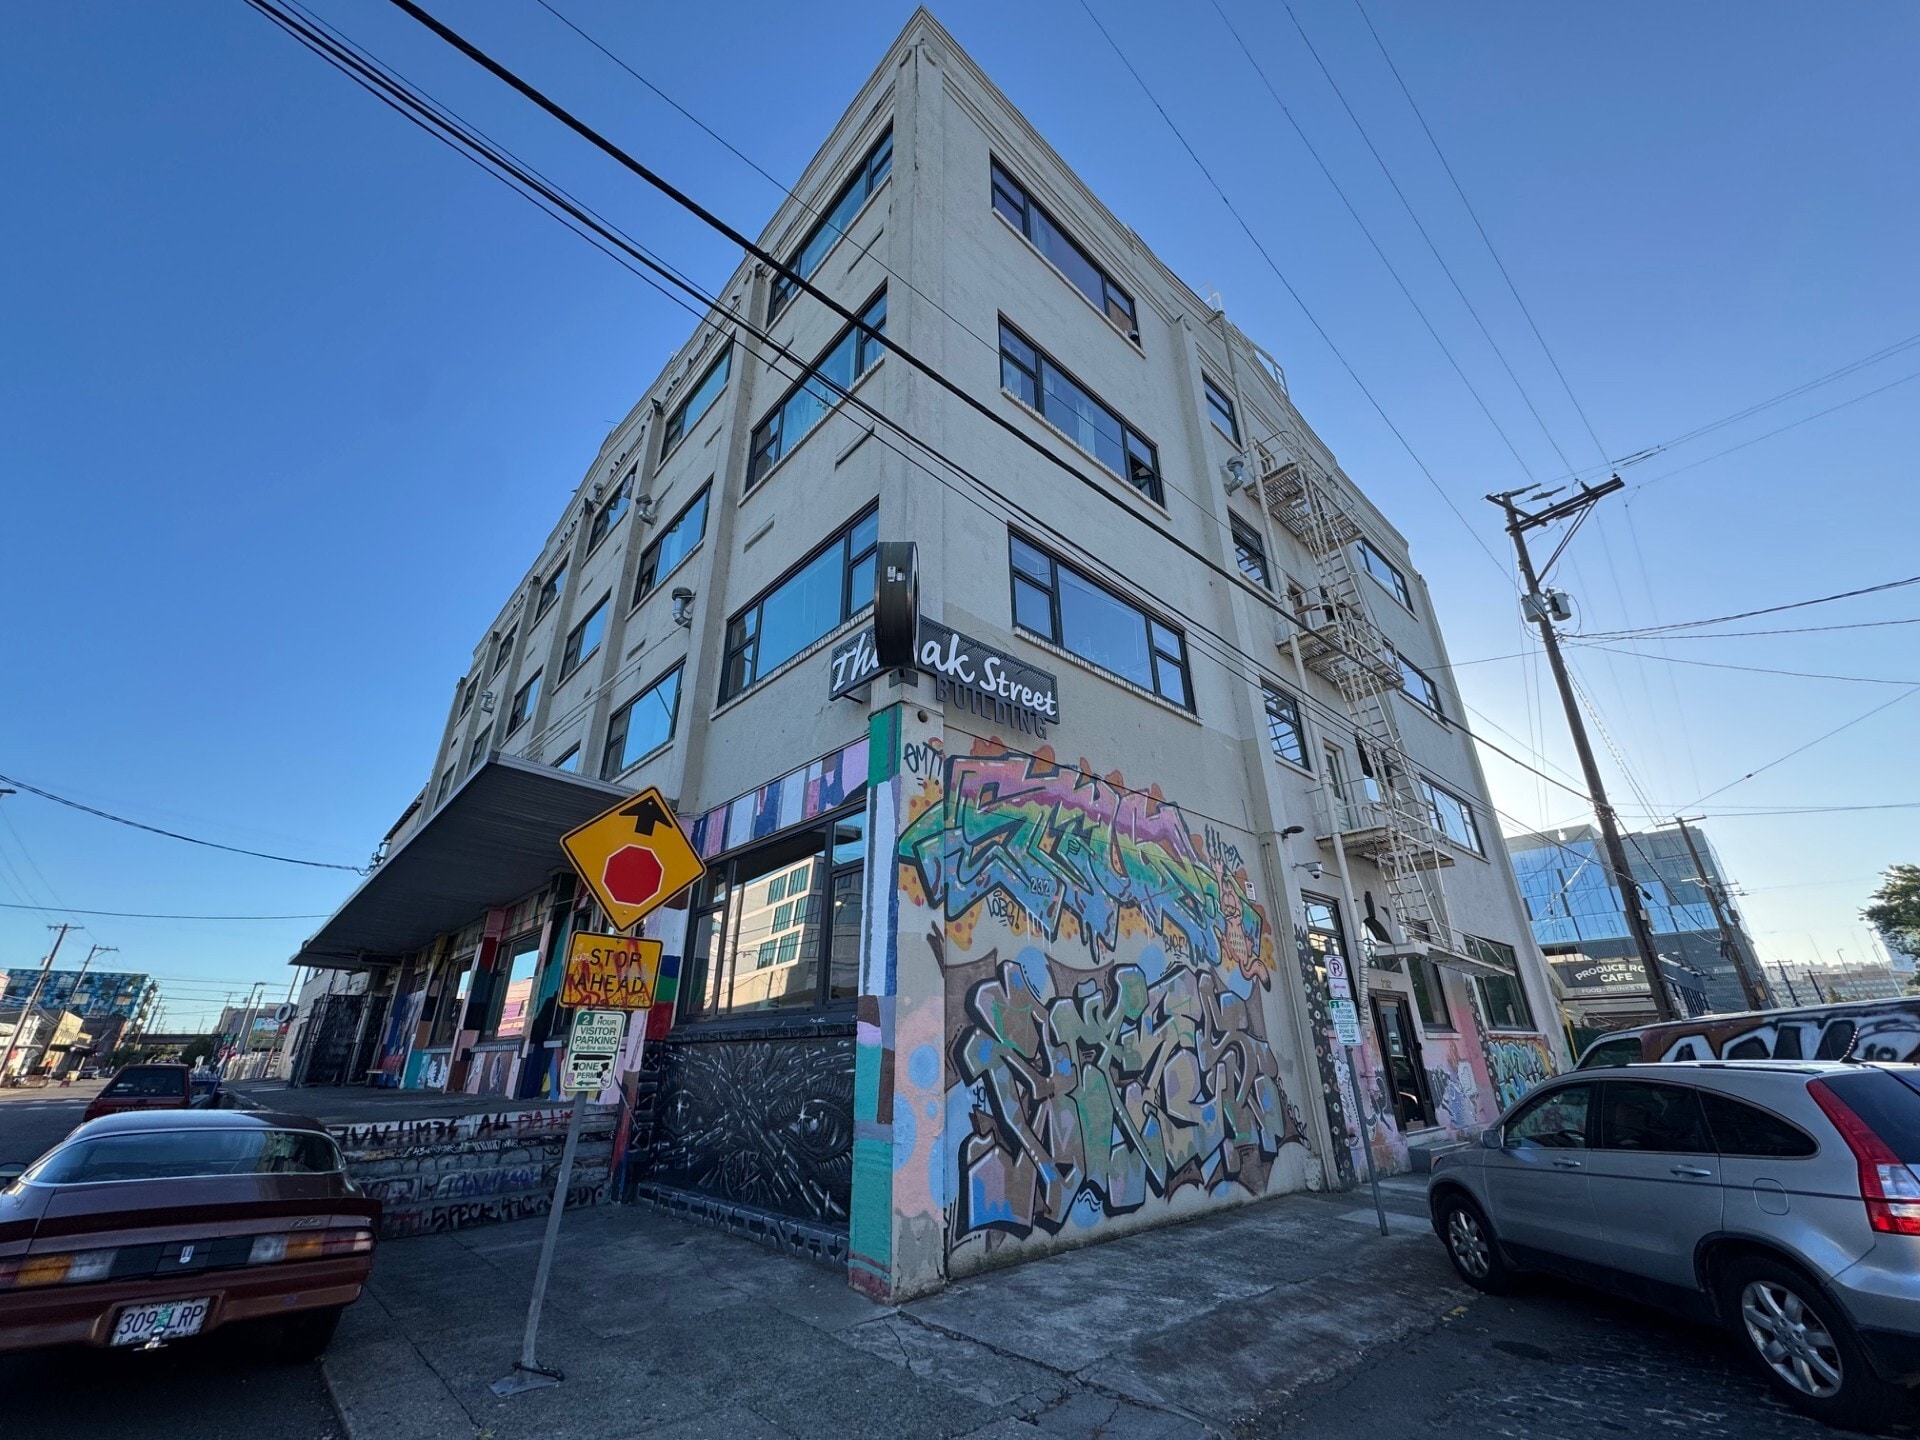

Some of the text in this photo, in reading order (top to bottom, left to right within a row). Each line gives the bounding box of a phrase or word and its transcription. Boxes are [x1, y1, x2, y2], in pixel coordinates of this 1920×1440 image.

[832, 632, 879, 692] Th
[979, 656, 1057, 716] Street
[936, 675, 1048, 741] BUILDING
[1031, 876, 1051, 897] 232
[589, 948, 642, 968] STOP
[1575, 964, 1627, 980] PRODUCE
[1600, 973, 1634, 982] CAFE
[574, 973, 645, 993] AHEAD
[582, 1015, 590, 1025] 2
[580, 1026, 617, 1036] VISITOR
[574, 1035, 618, 1045] PARKING
[577, 1062, 600, 1071] ONE
[576, 1071, 601, 1079] PERM
[120, 1305, 204, 1335] 309 LRP
